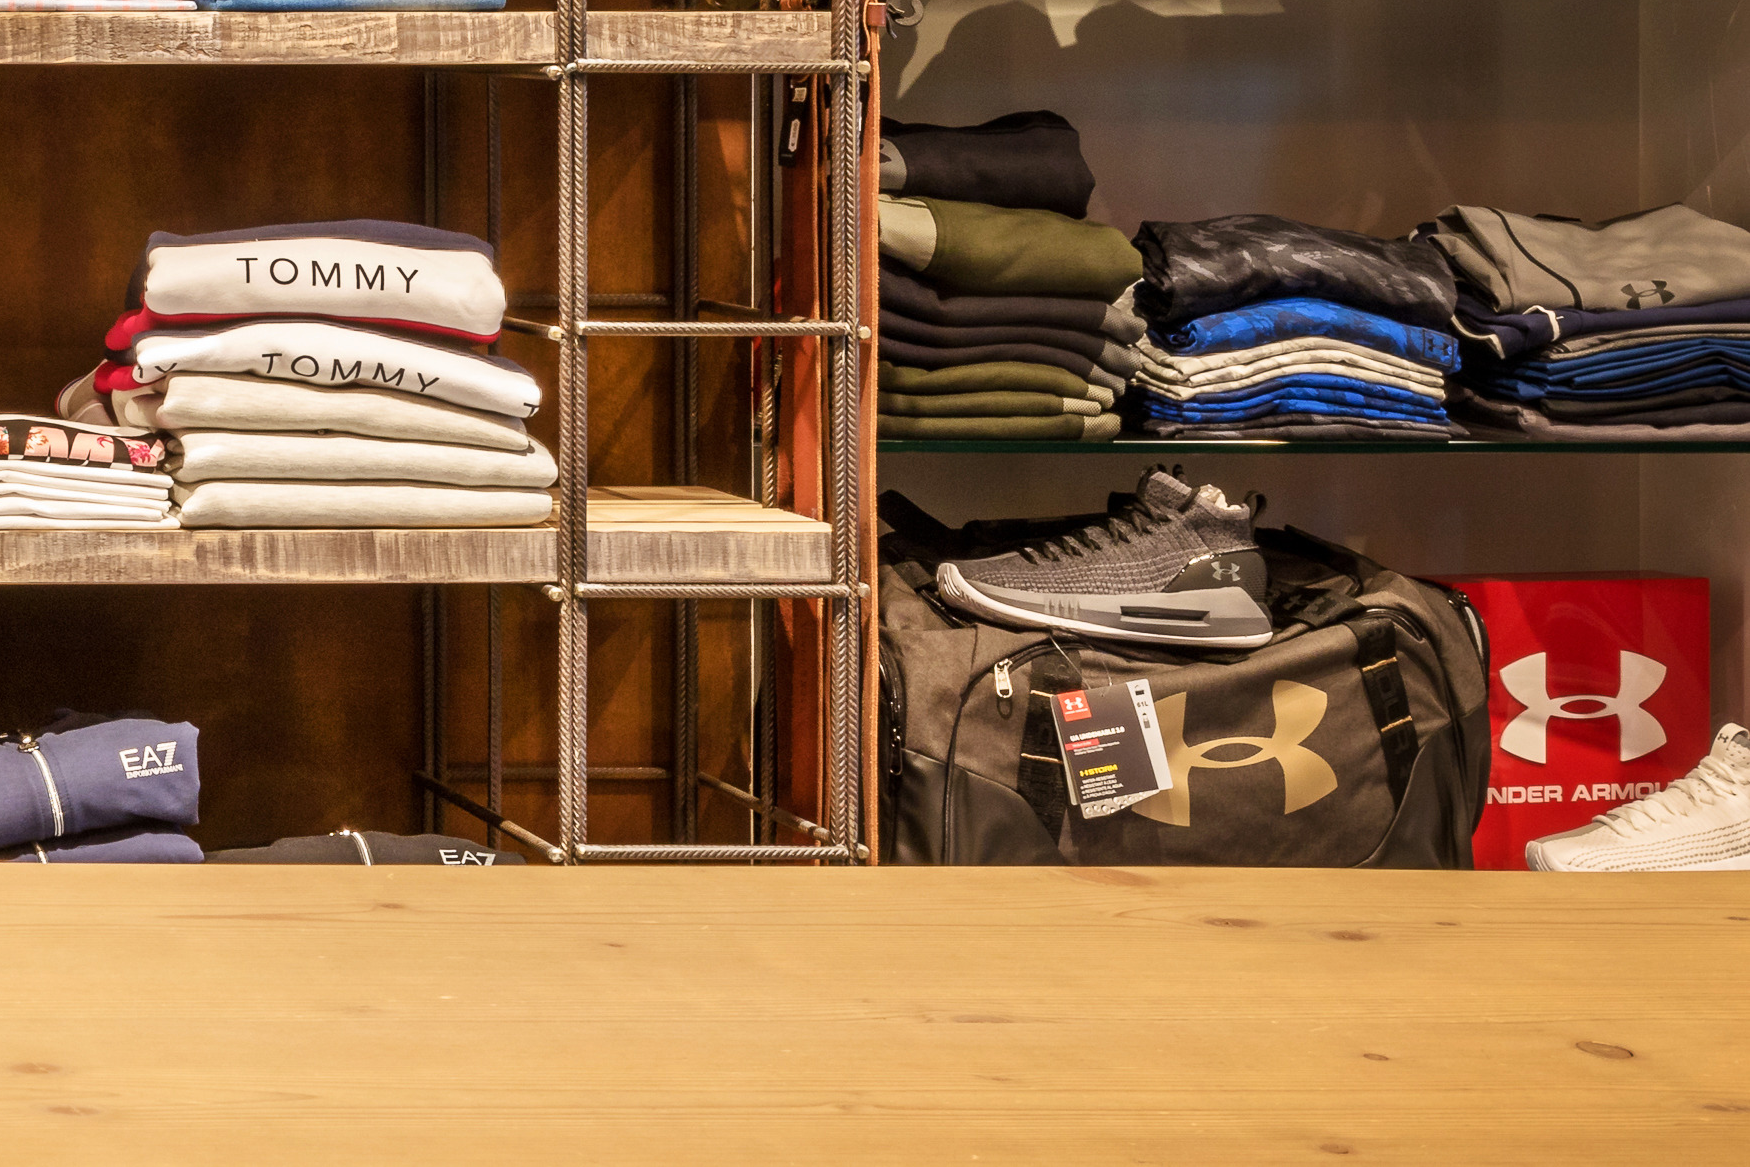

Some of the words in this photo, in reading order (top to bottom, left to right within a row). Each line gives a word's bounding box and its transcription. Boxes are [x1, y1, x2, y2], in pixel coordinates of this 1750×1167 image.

[236, 257, 419, 294] TOMMY
[262, 353, 440, 394] TOMMY
[119, 741, 177, 772] EA7
[1487, 785, 1563, 804] NDER
[1571, 782, 1663, 802] ARMO
[439, 849, 496, 866] EA7
